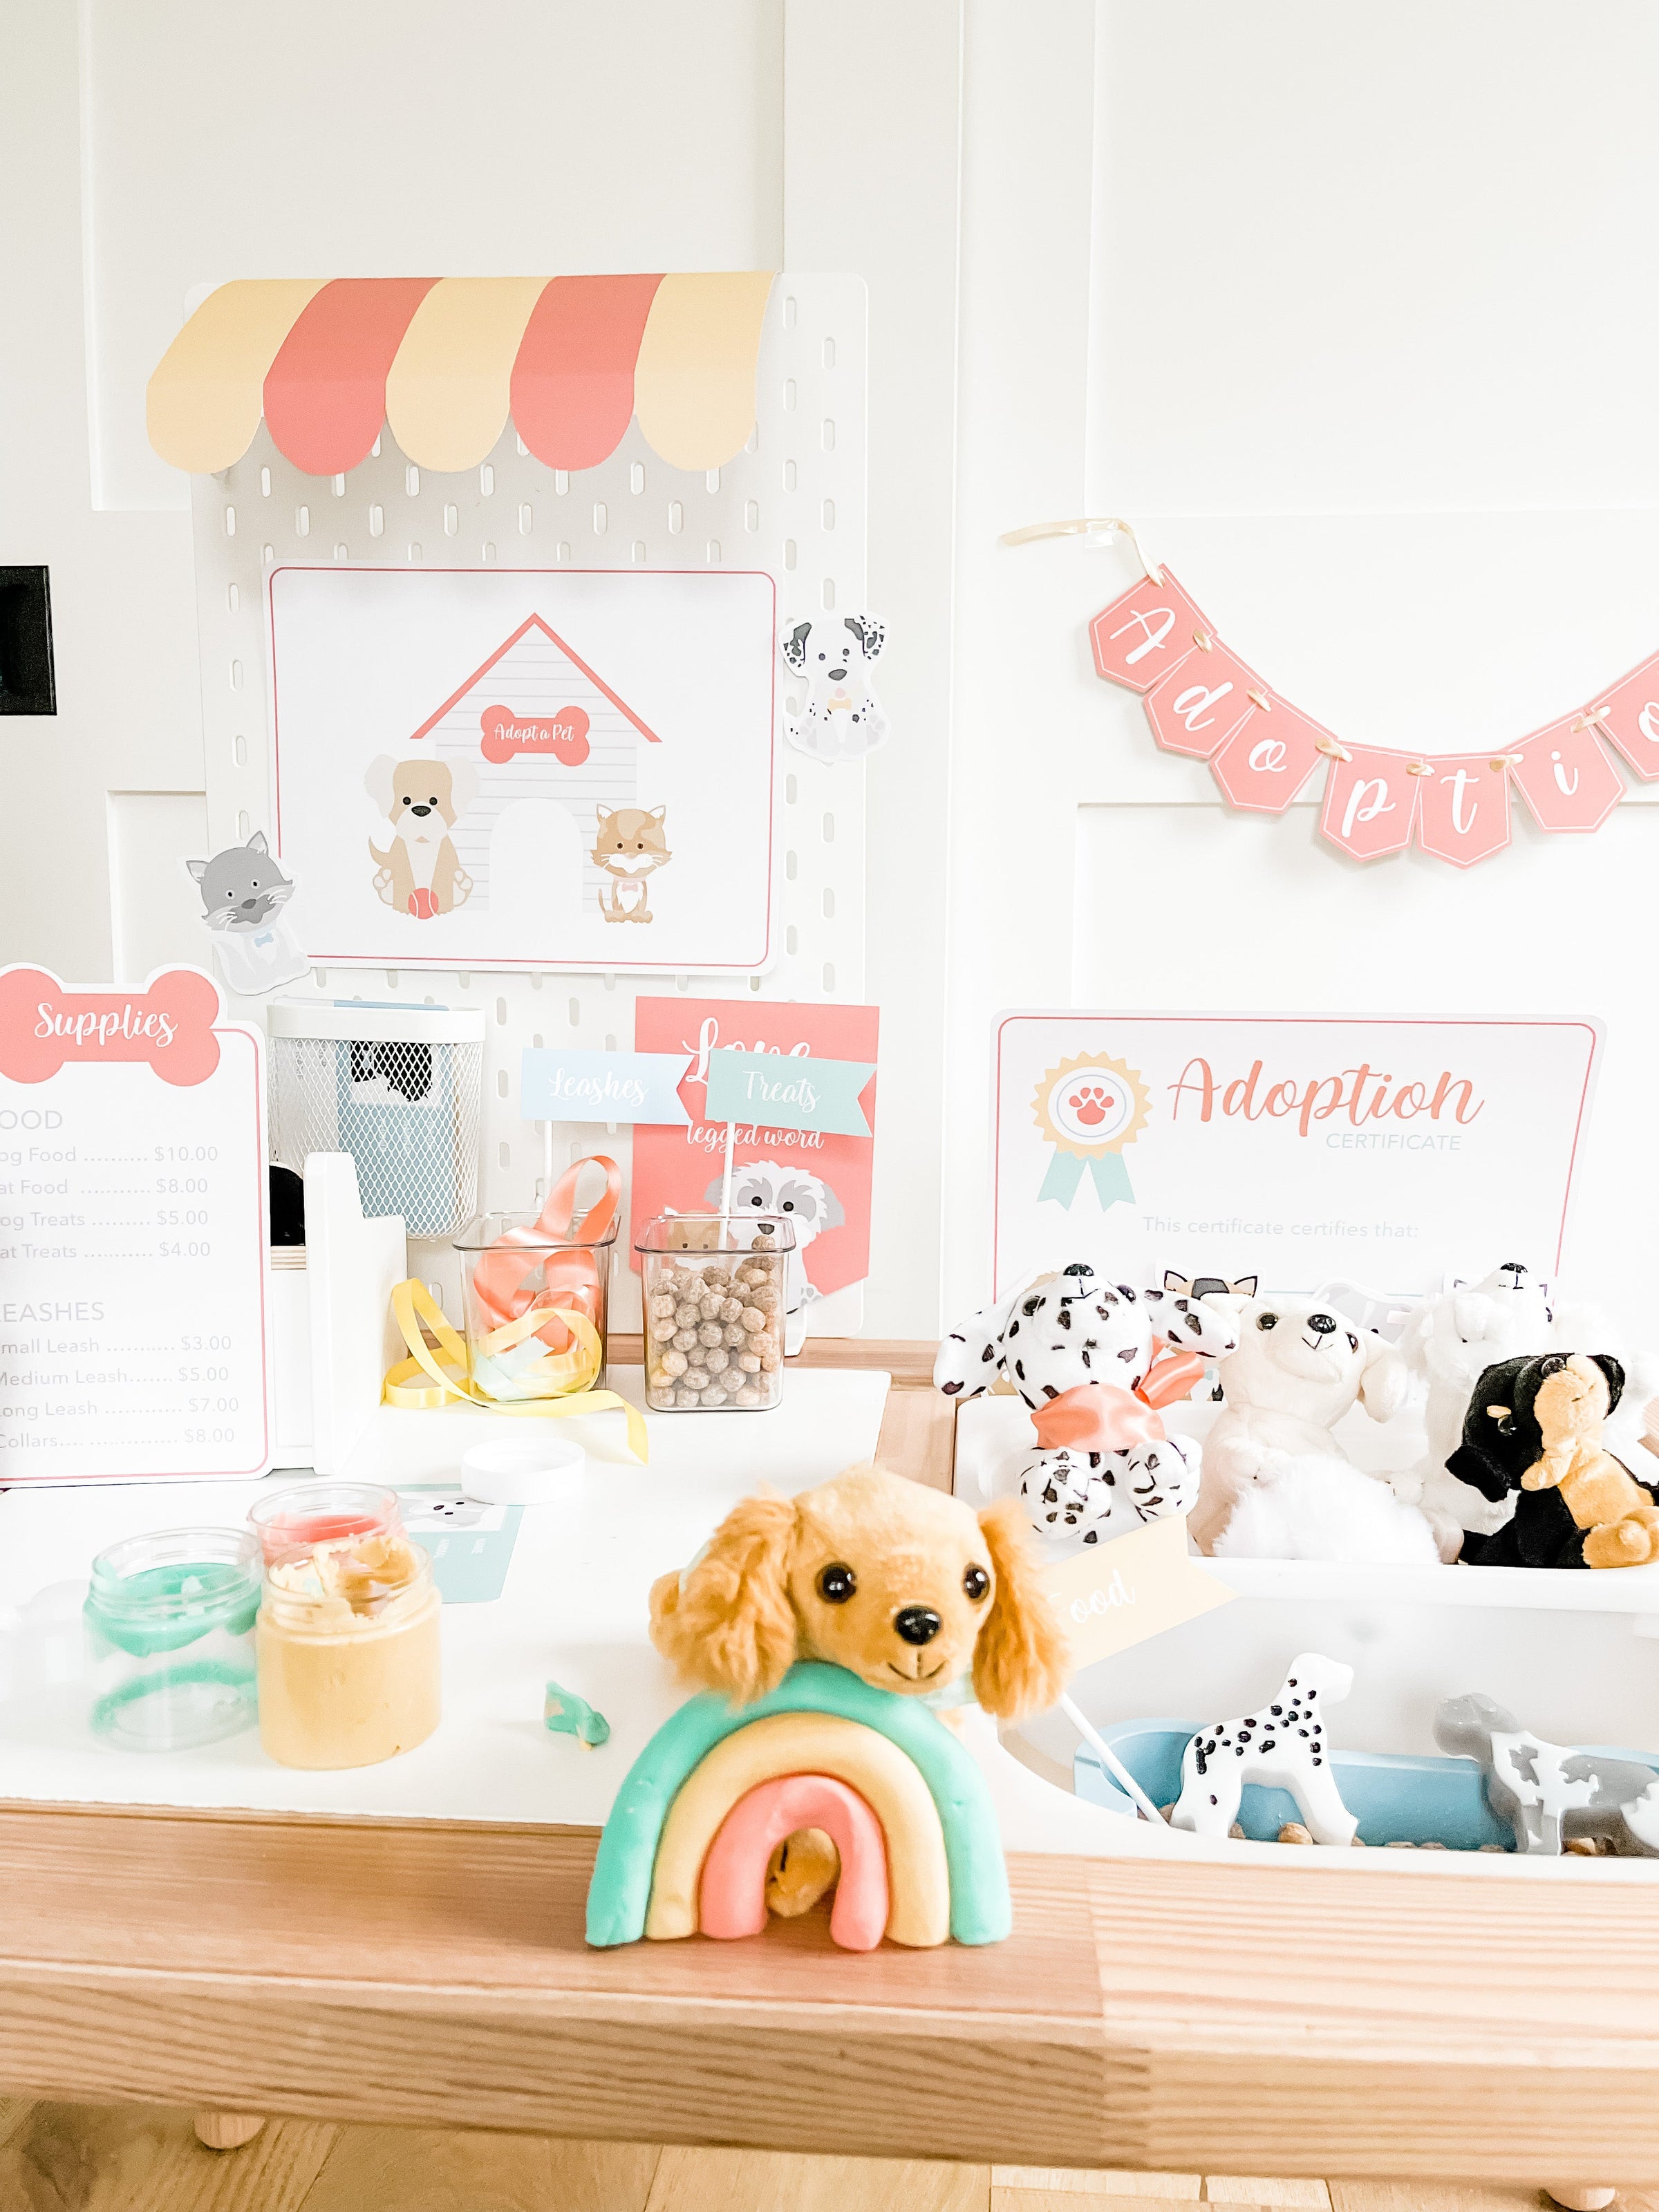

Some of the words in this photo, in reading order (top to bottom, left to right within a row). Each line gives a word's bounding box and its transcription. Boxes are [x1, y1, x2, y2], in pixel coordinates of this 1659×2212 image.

[494, 723, 538, 744] Adopt
[539, 729, 550, 740] a
[552, 724, 575, 742] Pet
[35, 1002, 178, 1047] Supplies
[548, 1067, 649, 1106] Leashes
[743, 1069, 822, 1113] Treats
[1167, 1058, 1485, 1137] Adoption
[0, 1109, 63, 1130] OOD
[1326, 1133, 1461, 1151] CERTIFICATE
[0, 1150, 22, 1166] og
[29, 1146, 77, 1163] Food
[154, 1146, 218, 1163] $10.00
[0, 1181, 15, 1195] at
[21, 1177, 68, 1194] Food
[156, 1178, 209, 1194] $8.00
[0, 1215, 24, 1231] og
[30, 1211, 85, 1227] Treats
[157, 1210, 209, 1226] $5.00
[1142, 1216, 1181, 1234] This
[1188, 1217, 1284, 1236] certificate
[1291, 1219, 1368, 1237] certifies
[1375, 1220, 1419, 1239] that:
[0, 1245, 17, 1259] at
[21, 1243, 77, 1259] Treats
[159, 1241, 211, 1258] $4.00
[0, 1302, 105, 1322] EASHES
[0, 1338, 40, 1354] mall
[47, 1336, 100, 1353] Leash
[181, 1335, 232, 1351] $3.00
[178, 1366, 229, 1382] $5.00
[0, 1403, 38, 1421] ong
[45, 1400, 98, 1416] Leash
[189, 1397, 239, 1413] $7.00
[184, 1427, 235, 1444] $8.00
[1049, 1568, 1137, 1624] ood
